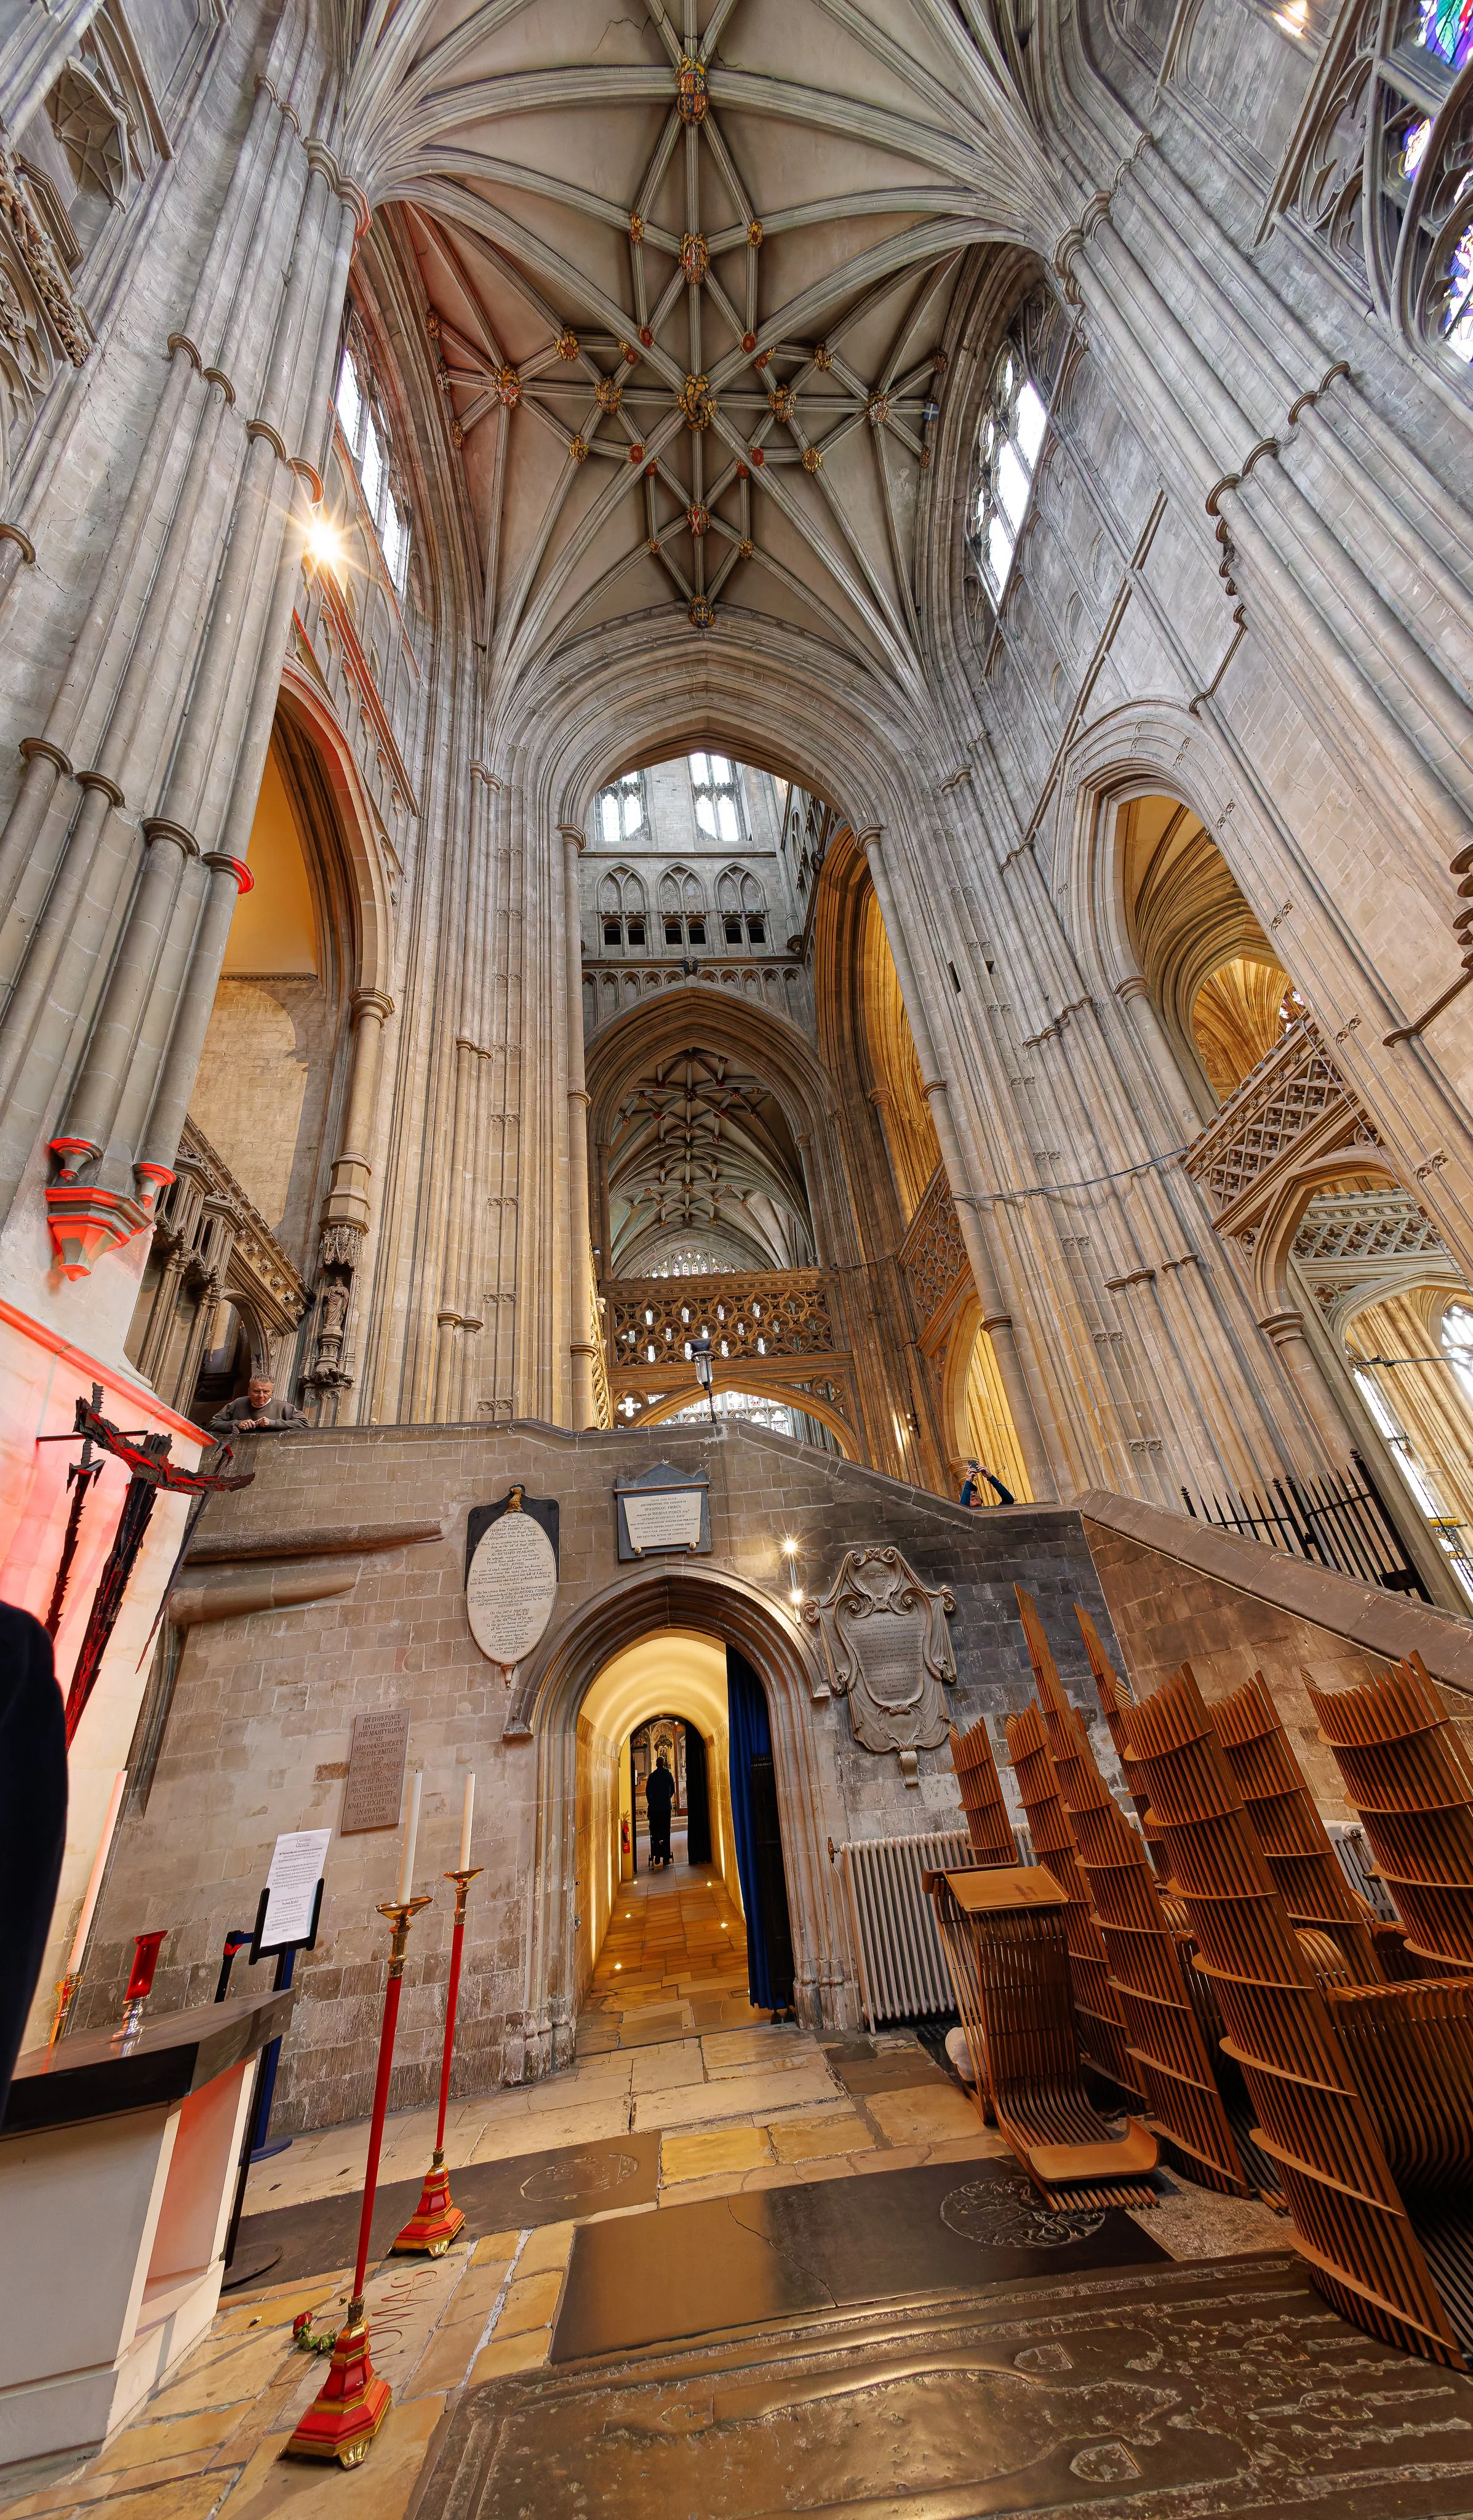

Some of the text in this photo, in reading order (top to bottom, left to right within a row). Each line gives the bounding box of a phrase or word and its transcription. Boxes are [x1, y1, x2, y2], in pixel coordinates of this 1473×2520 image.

[362, 1721, 393, 1730] HALLOWED
[369, 1726, 404, 1736] MARTYRDOM
[356, 1742, 380, 1752] THOMAS
[367, 1747, 398, 1756] DECEMBER
[351, 1774, 399, 1787] ROBERT RUNCIE
[351, 1784, 389, 1794] ARCHBISHOP
[348, 1796, 397, 1809] KNELT TOGETHER
[364, 1805, 386, 1814] PRAYER
